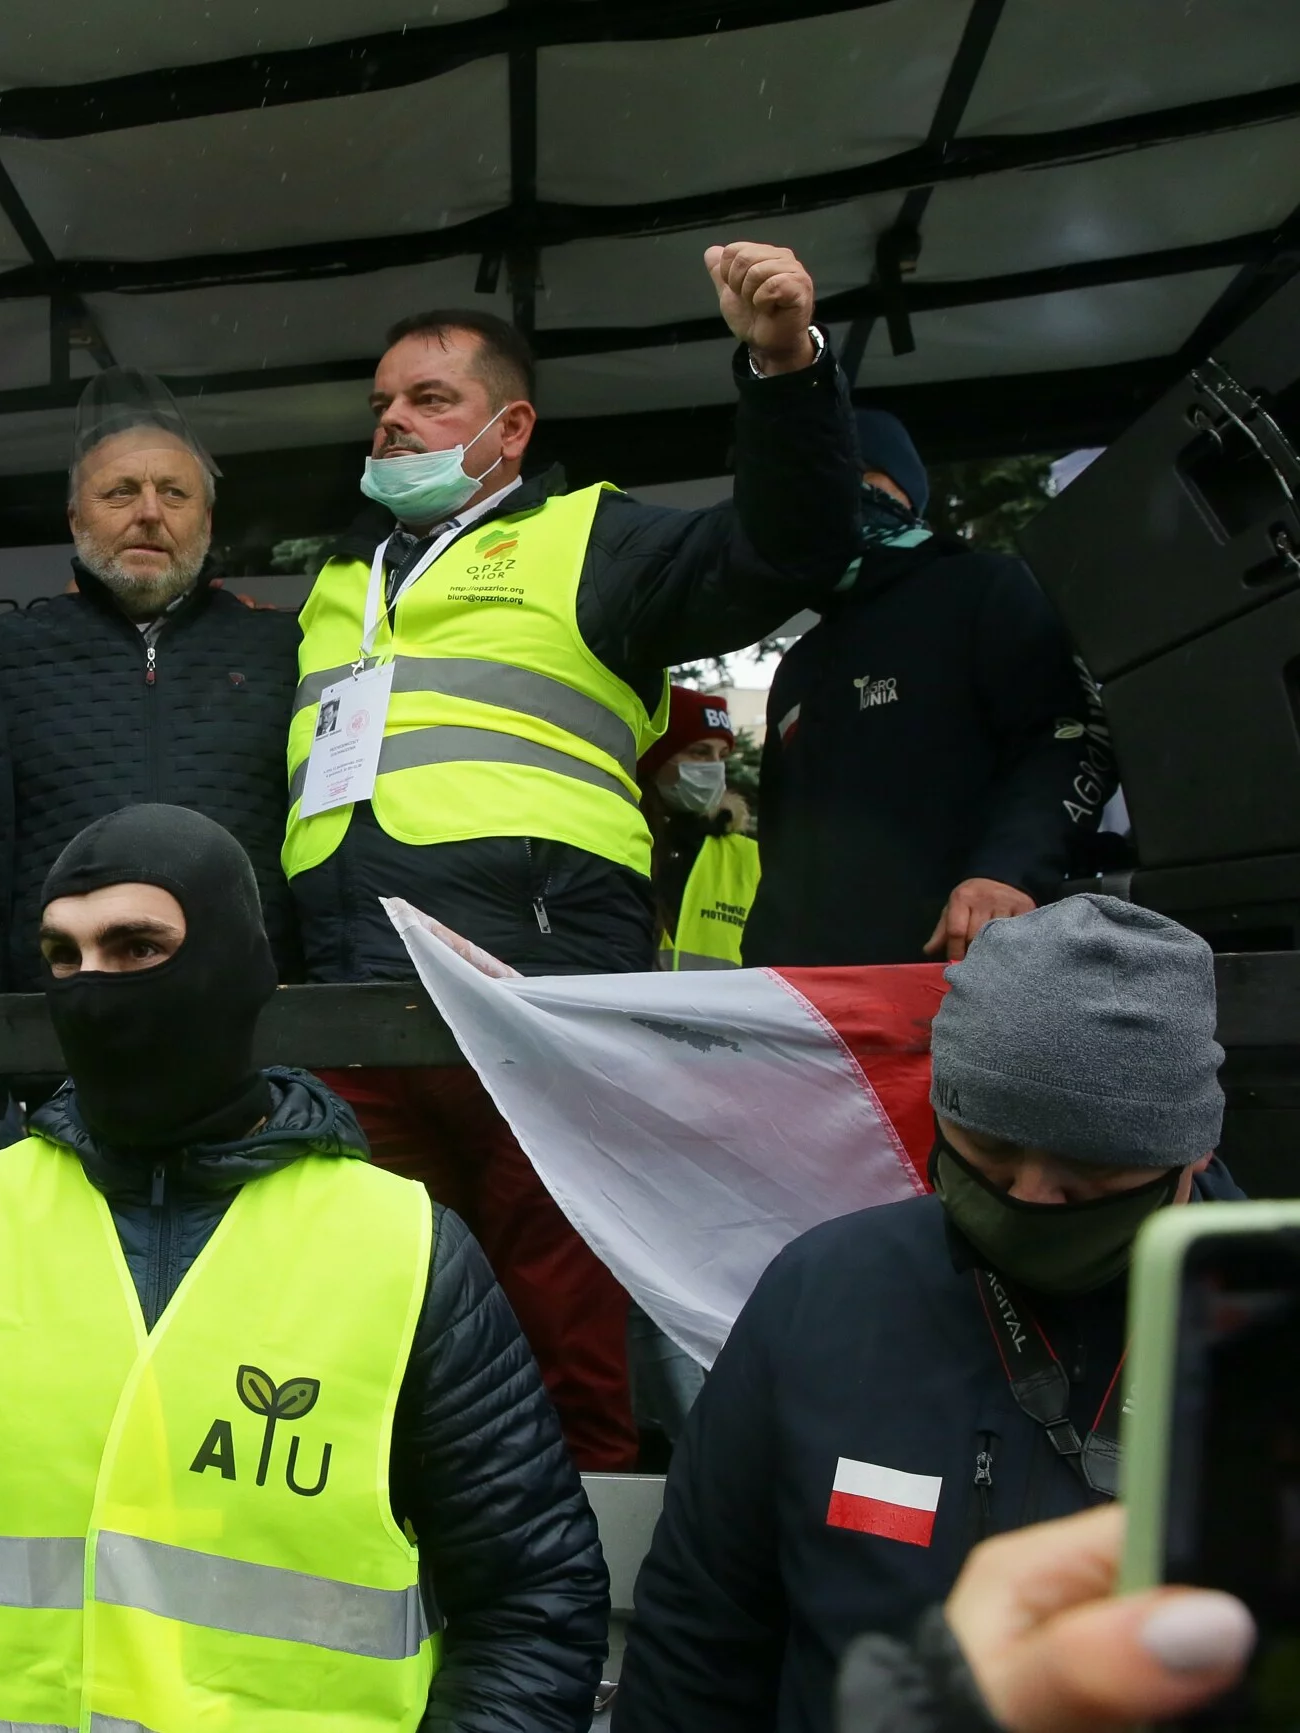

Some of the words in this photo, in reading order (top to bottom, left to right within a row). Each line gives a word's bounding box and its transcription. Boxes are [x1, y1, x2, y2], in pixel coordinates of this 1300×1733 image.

[466, 559, 516, 574] OPZZ
[472, 572, 505, 581] RIOR
[447, 594, 524, 605] biuro@opzzrior.org
